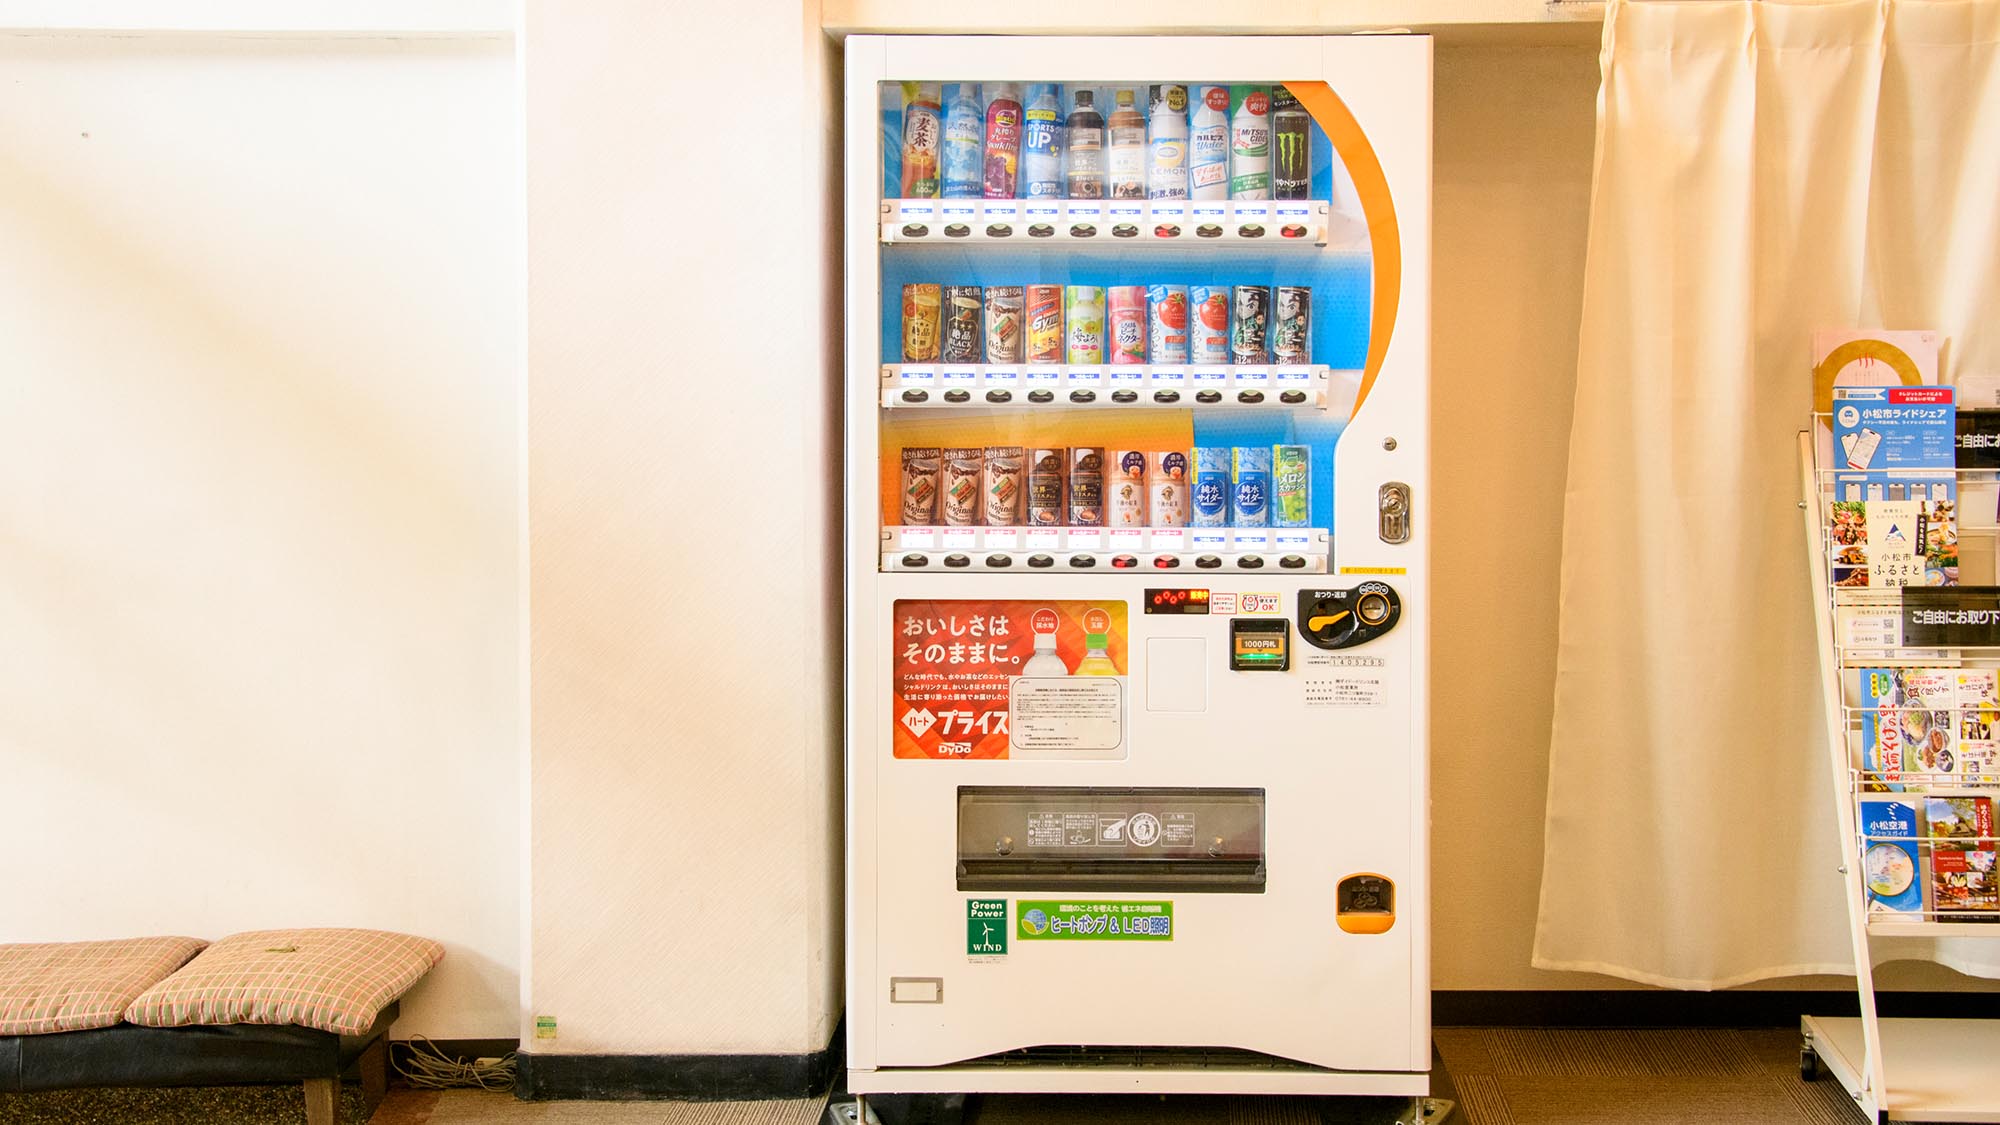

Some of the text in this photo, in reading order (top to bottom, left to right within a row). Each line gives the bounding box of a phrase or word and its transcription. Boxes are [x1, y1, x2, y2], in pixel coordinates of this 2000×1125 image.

[914, 117, 931, 147] 麦茶
[1028, 124, 1055, 132] SPORTS
[1027, 131, 1051, 149] UP
[1197, 142, 1223, 150] Water
[1032, 313, 1059, 333] Gym
[1862, 408, 1947, 419] 小松市ライドシェア
[1280, 472, 1306, 483] メロン
[1200, 485, 1219, 493] 純水
[1241, 485, 1259, 493] 純水
[1279, 483, 1306, 493] スカッシュ
[1196, 493, 1223, 503] サイダー
[1237, 493, 1263, 503] サイダー
[1881, 553, 1911, 561] 小松市
[1874, 564, 1920, 576] ふるさと
[1314, 591, 1347, 599] おつり・返却
[1262, 603, 1274, 611] OK
[902, 614, 1009, 637] おいしさは
[1244, 640, 1277, 648] 1000円札
[902, 642, 1020, 665] そのままに。
[903, 673, 1009, 681] どんな時代でも、水やお茶などのエッセン
[908, 709, 1009, 735] ハート プライス
[938, 743, 972, 756] DyDo
[1869, 820, 1908, 831] 小松空港
[971, 901, 1003, 910] Green
[1059, 904, 1120, 913] 環境のことを考えた
[970, 909, 1004, 918] Power
[1050, 915, 1170, 936] ヒートポンプ & LED照明
[973, 943, 1003, 952] WIND
